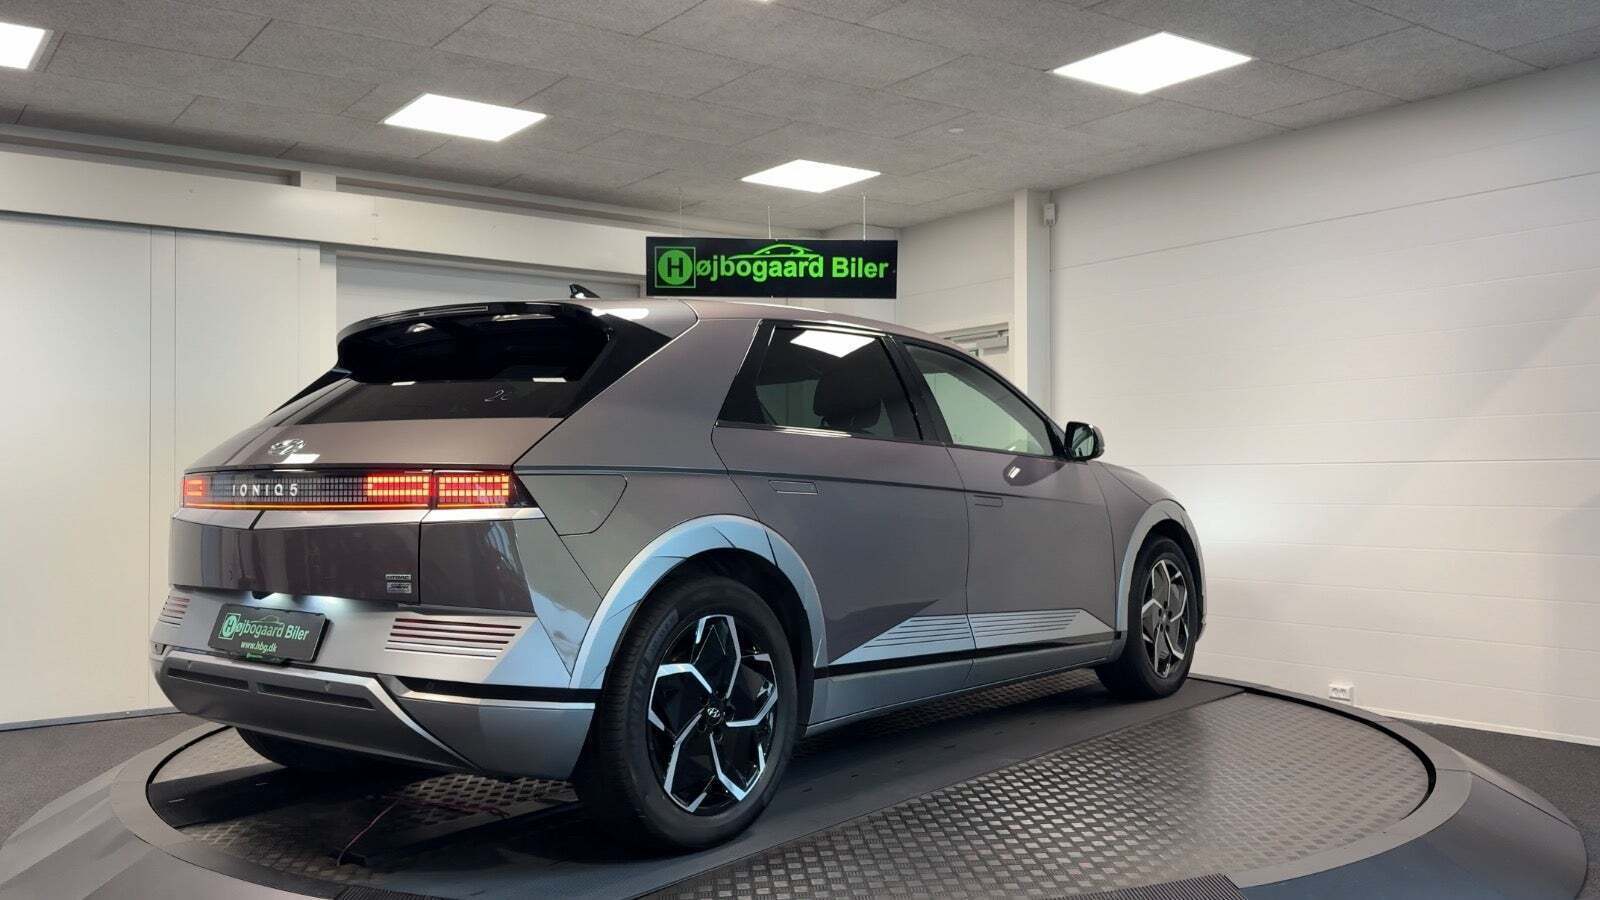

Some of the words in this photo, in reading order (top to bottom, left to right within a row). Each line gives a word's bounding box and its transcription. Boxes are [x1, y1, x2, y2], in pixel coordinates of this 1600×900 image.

[661, 252, 824, 283] Højbogaard
[832, 256, 889, 278] Biler
[285, 624, 310, 640] Biler
[240, 640, 278, 654] www.hbg.dk
